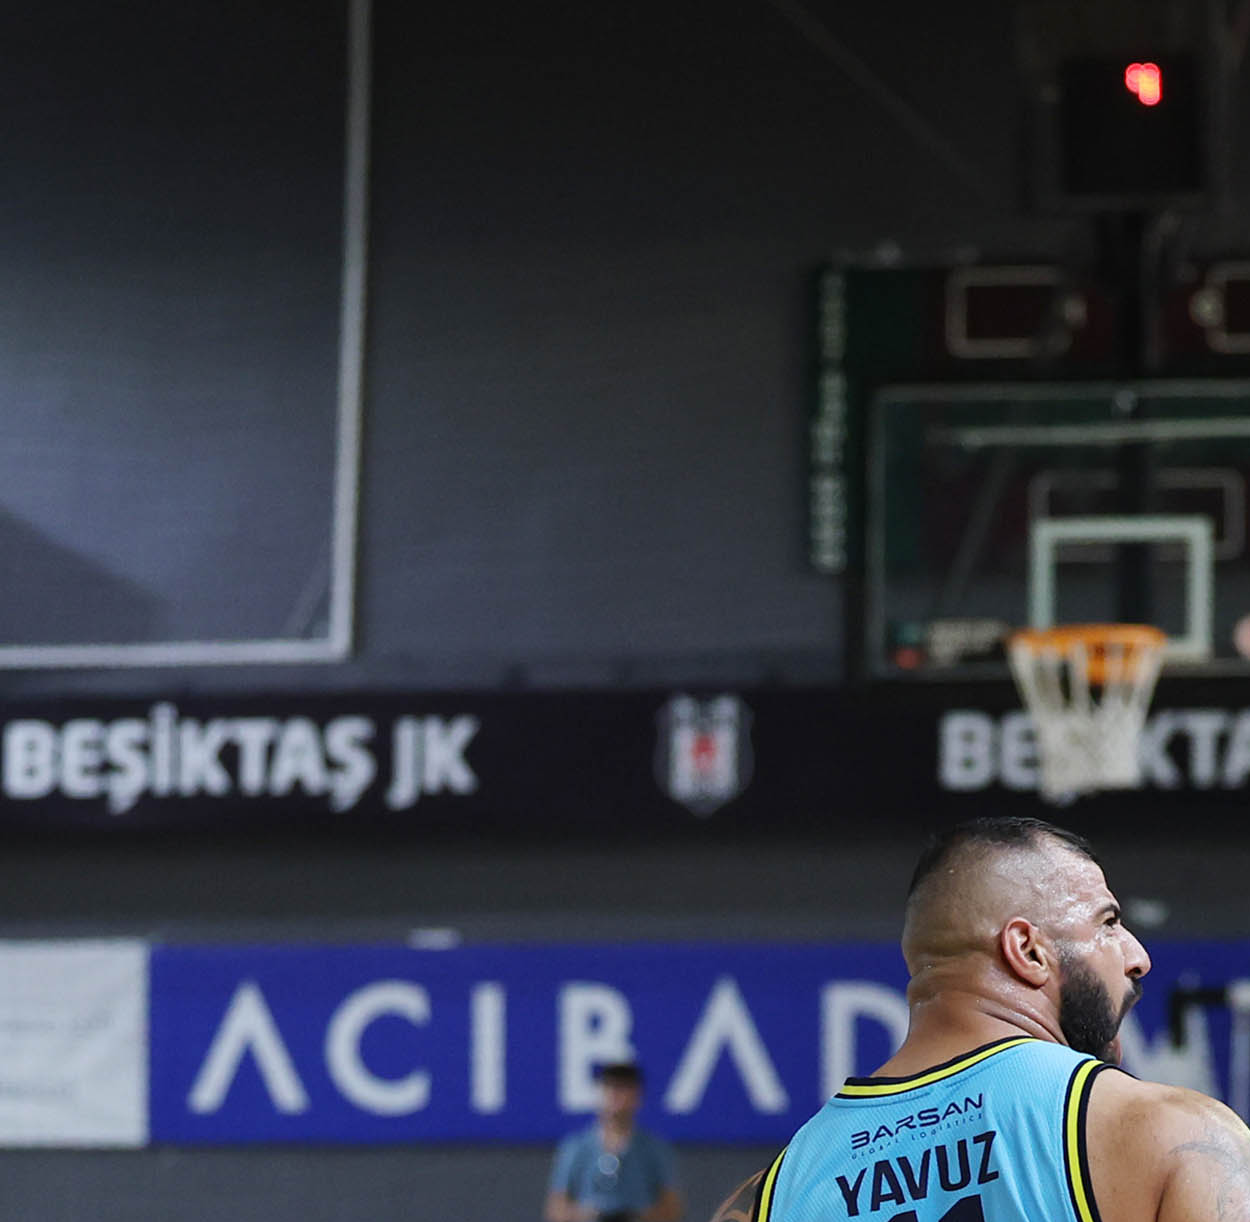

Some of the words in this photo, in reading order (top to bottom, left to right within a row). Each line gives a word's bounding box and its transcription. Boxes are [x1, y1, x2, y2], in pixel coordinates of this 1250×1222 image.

[3, 703, 377, 812] BEŞİKTAŞ
[385, 714, 480, 811] JK
[851, 1093, 983, 1150] BARSAN
[835, 1130, 1000, 1218] YAVUZ
